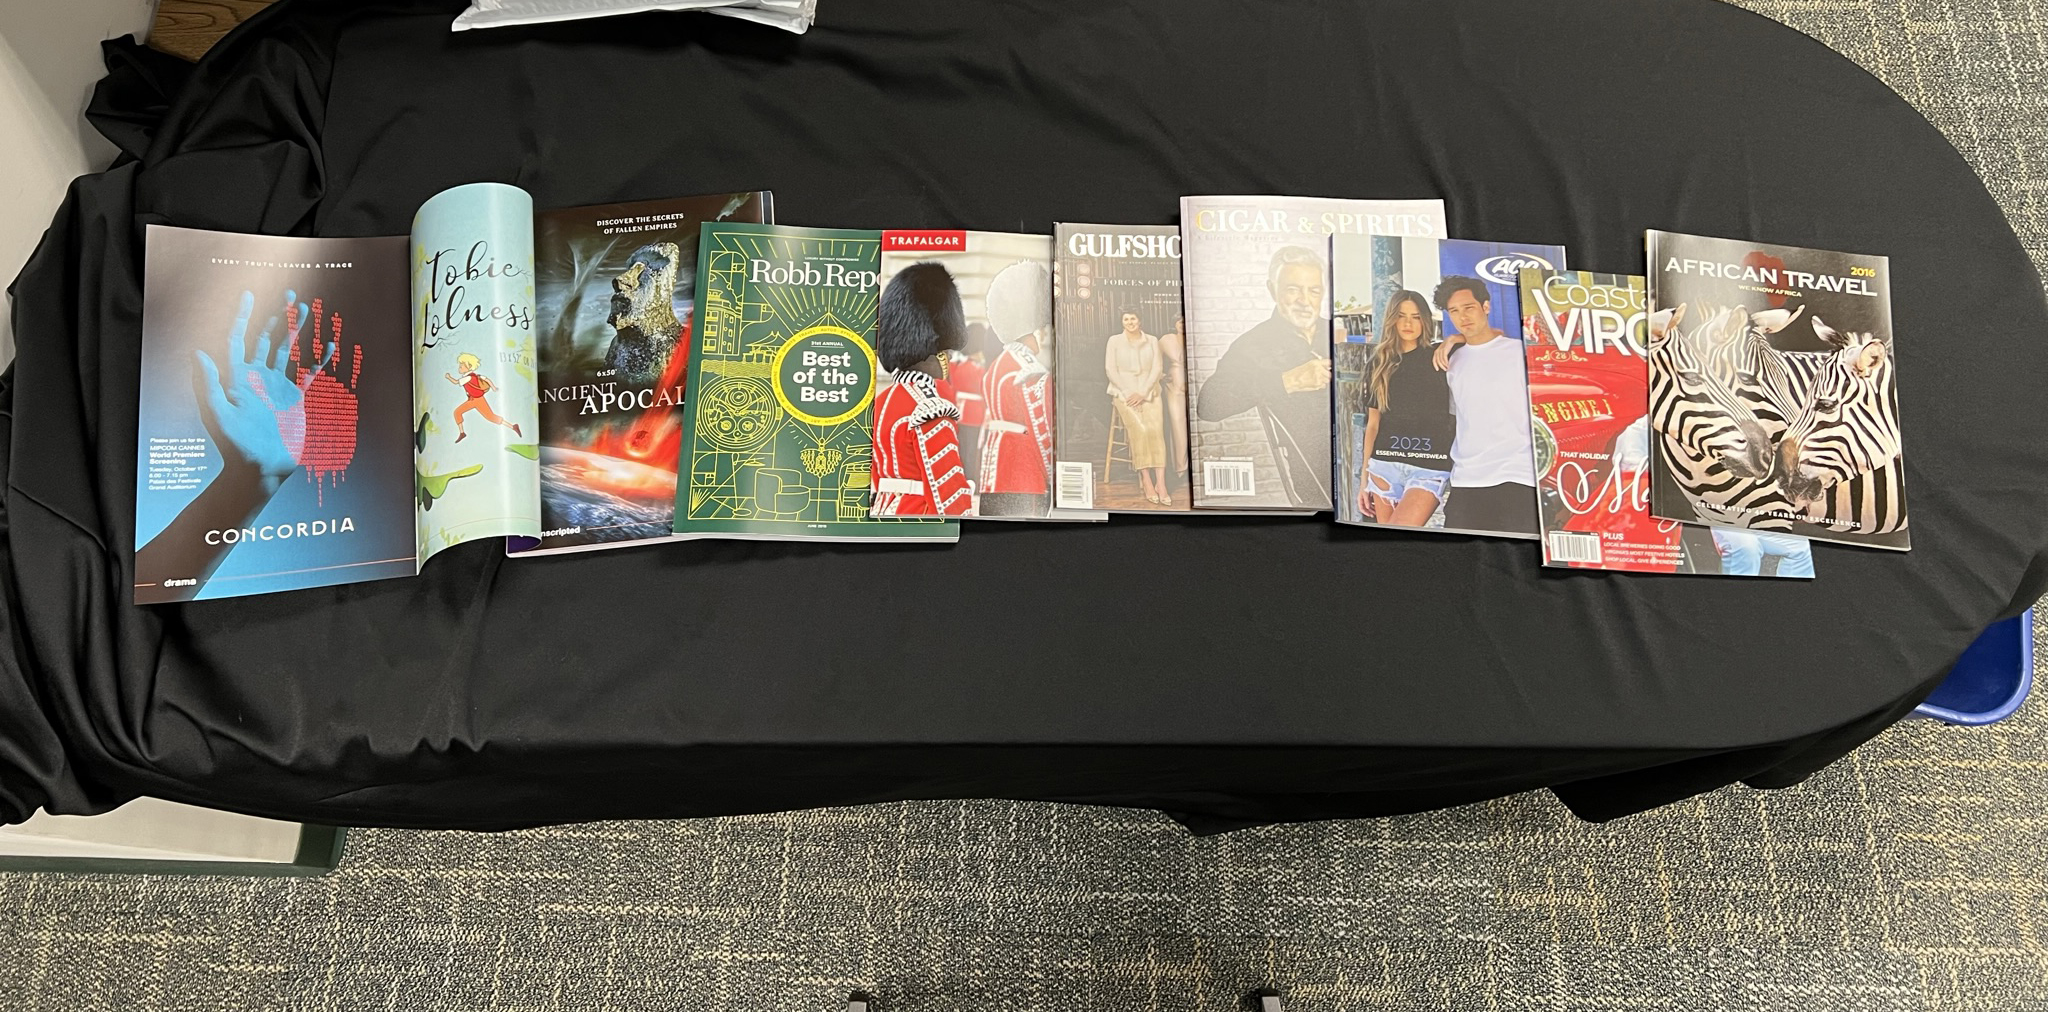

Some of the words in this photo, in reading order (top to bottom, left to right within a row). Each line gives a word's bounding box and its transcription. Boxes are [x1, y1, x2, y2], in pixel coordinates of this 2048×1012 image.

[596, 217, 634, 226] DISCOVER
[652, 213, 684, 222] SECRETS
[616, 226, 642, 234] FALLEN
[644, 222, 678, 231] EMPIRES
[1196, 209, 1290, 234] CIGAR
[1297, 217, 1315, 234] &
[1322, 212, 1434, 236] SPIRITS
[890, 236, 959, 246] TRAFALGAR
[1068, 233, 1181, 258] GULFSHO
[426, 240, 522, 303] Tobie
[749, 259, 821, 286] Robb
[1665, 257, 1777, 285] AFRICAN
[1783, 270, 1878, 296] TRAVEL
[1850, 267, 1876, 277] 2016
[1752, 286, 1774, 294] KNOW
[1775, 289, 1802, 297] AFRICA
[421, 286, 534, 354] Lolness
[802, 351, 851, 367] Best
[793, 368, 816, 384] of
[821, 368, 858, 385] the
[538, 382, 617, 404] NCIENT
[579, 386, 685, 415] APOCAL
[800, 386, 849, 403] Best
[1390, 436, 1432, 451] 2023
[1407, 452, 1448, 460] SPORTSWEAR
[1696, 502, 1752, 513] CELEBRATING
[1768, 510, 1795, 518] YEARS
[1810, 516, 1861, 528] EXCELLENCE
[204, 517, 354, 545] CONCORDIA
[540, 526, 580, 537] nscripted
[1603, 532, 1624, 540] PLUS
[164, 578, 196, 587] drama
